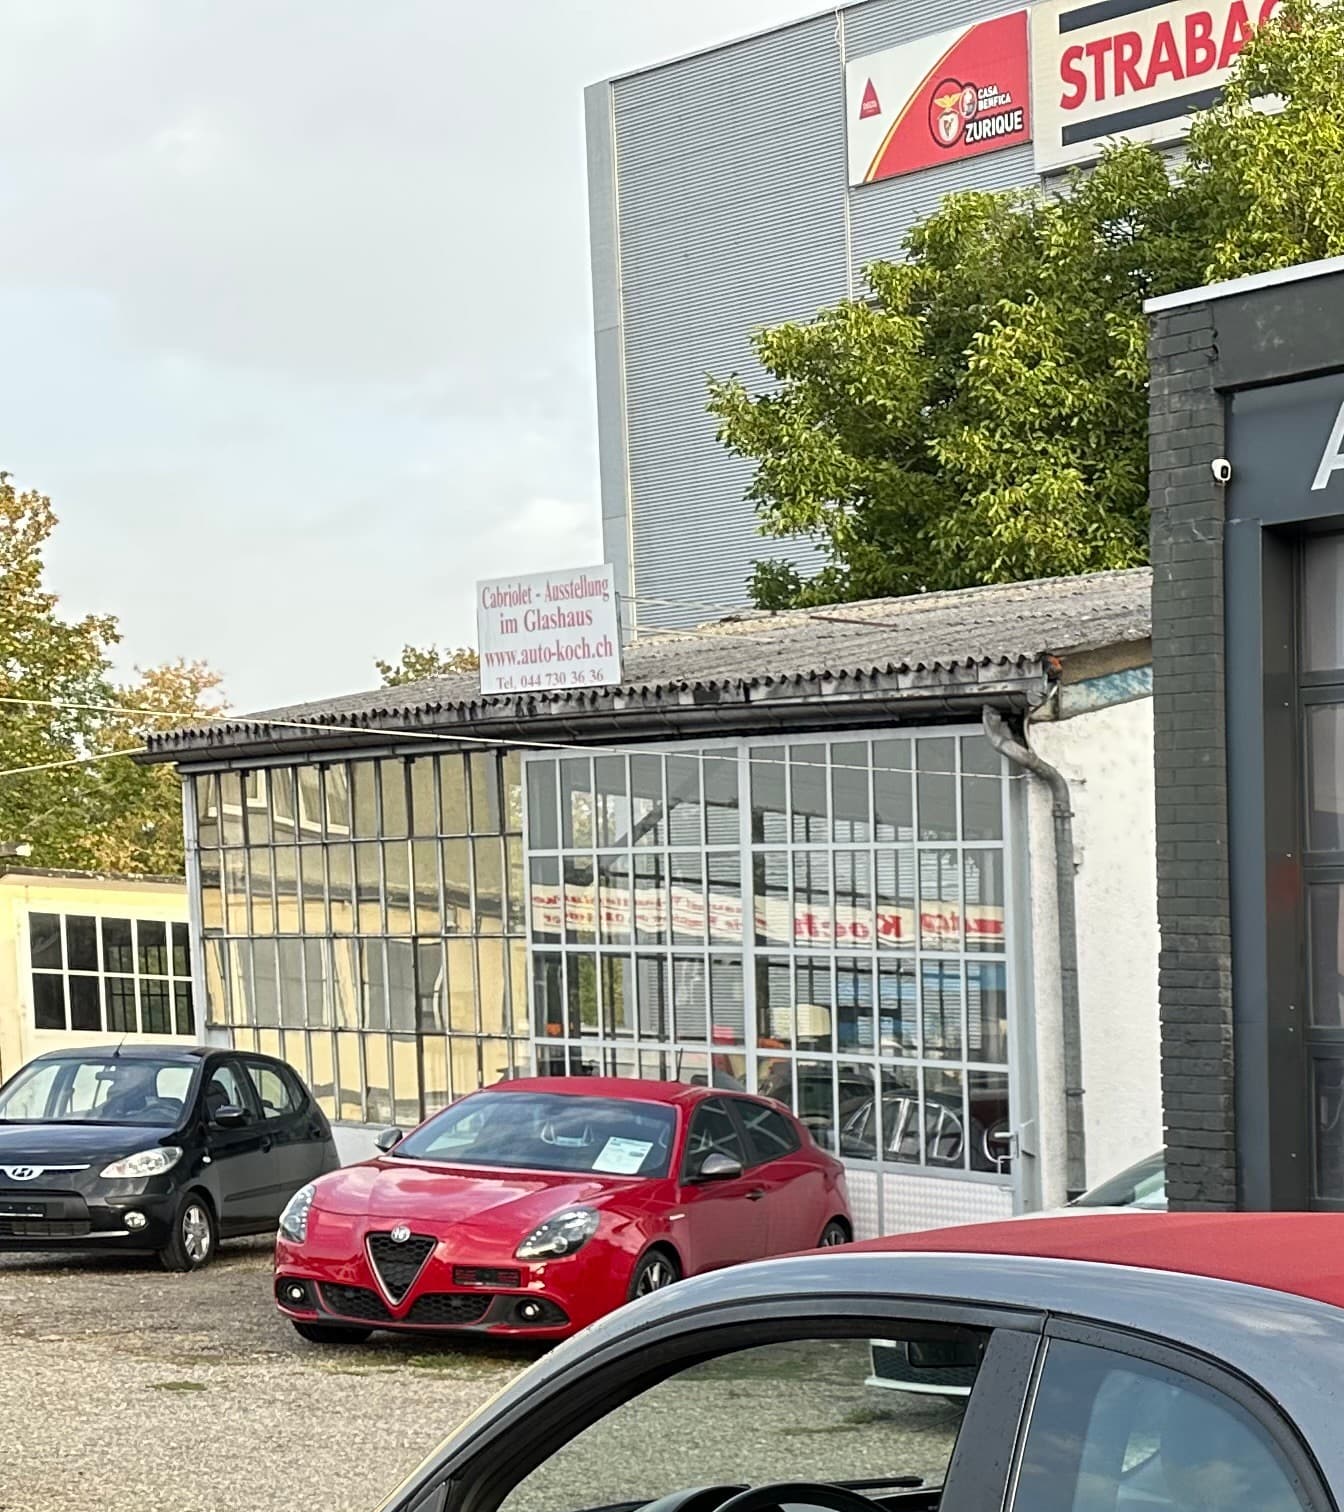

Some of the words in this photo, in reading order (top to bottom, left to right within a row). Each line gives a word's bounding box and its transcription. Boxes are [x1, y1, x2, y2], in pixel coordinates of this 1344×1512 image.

[977, 85, 998, 99] CASA
[978, 93, 1011, 111] BENFICA
[965, 110, 1023, 143] ZURIQUE
[482, 583, 532, 610] Cabriolet
[544, 574, 610, 603] Ausstellung
[500, 612, 518, 635] im
[524, 606, 593, 632] Glashaus
[485, 634, 613, 668] www.auto-koch.ch
[521, 675, 541, 687] 044
[546, 672, 566, 686] 730
[571, 671, 585, 685] 36
